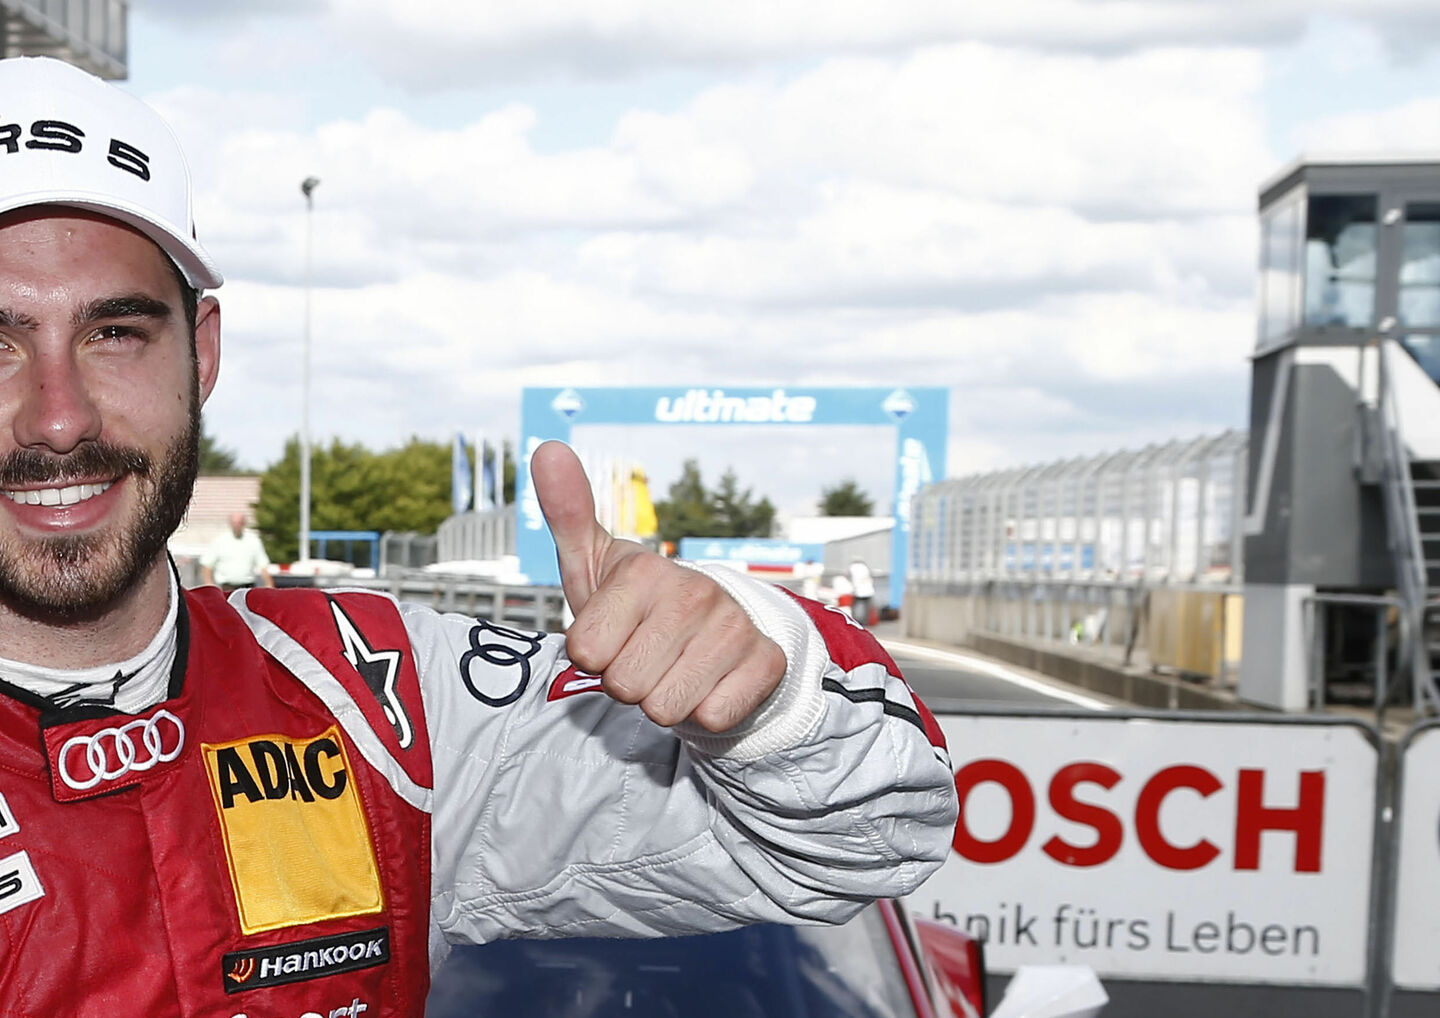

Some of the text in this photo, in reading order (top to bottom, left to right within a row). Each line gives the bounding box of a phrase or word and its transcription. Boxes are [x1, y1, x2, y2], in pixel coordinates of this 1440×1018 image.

[106, 137, 151, 182] 5
[654, 389, 817, 423] ultimate
[215, 737, 348, 810] ADAC
[952, 758, 1326, 874] OSCH
[1054, 904, 1151, 951] fürs
[1165, 911, 1321, 957] Leben
